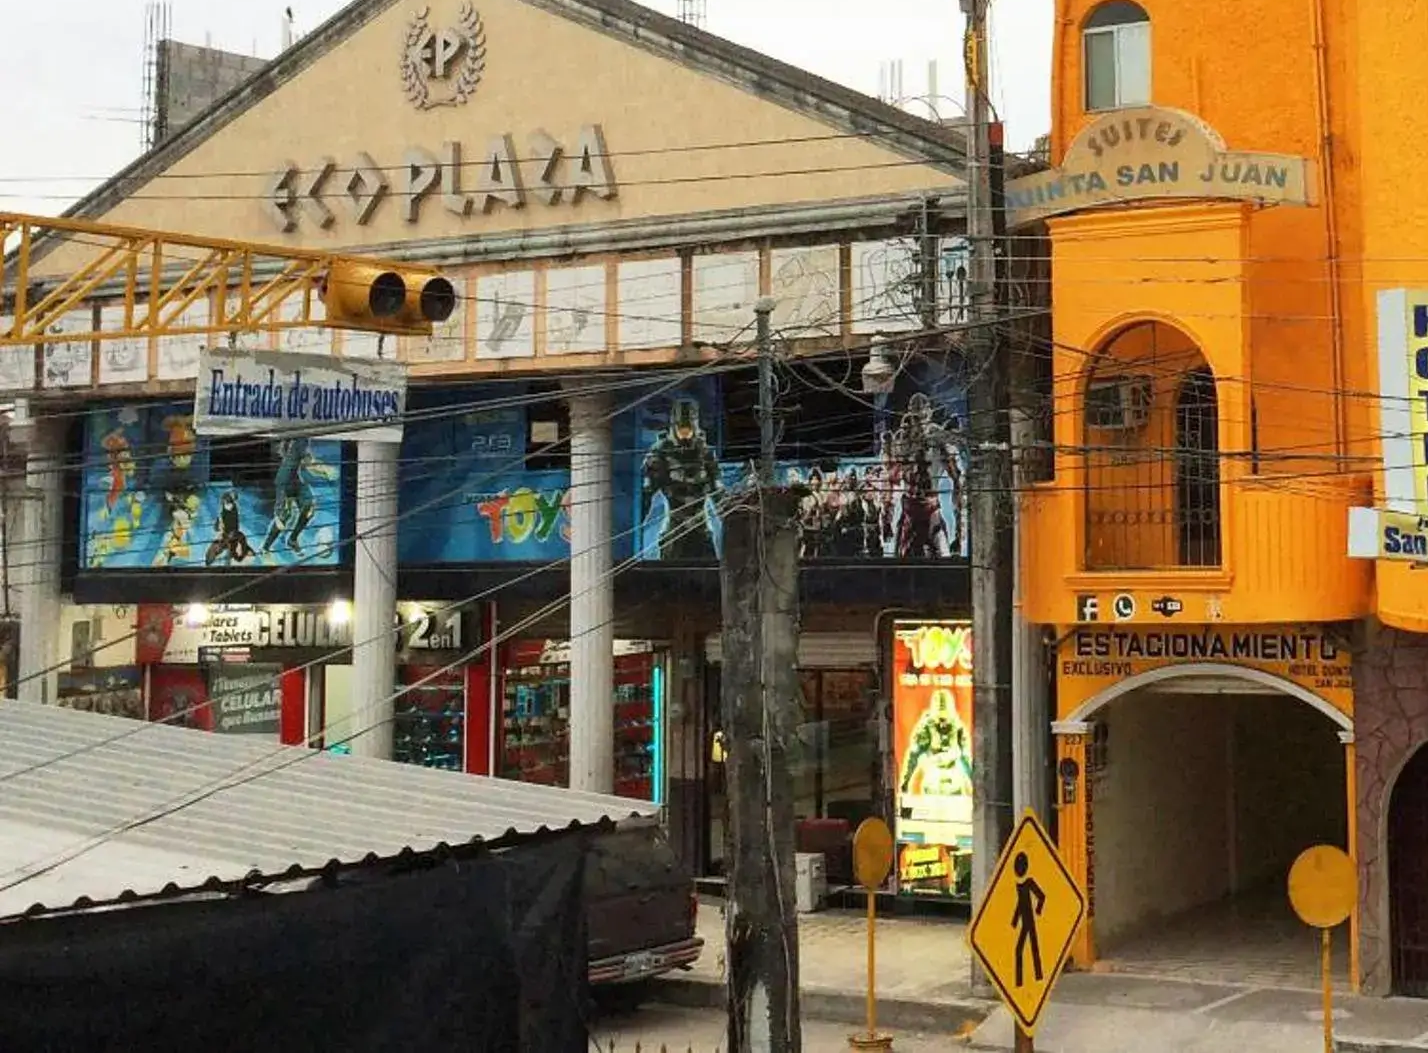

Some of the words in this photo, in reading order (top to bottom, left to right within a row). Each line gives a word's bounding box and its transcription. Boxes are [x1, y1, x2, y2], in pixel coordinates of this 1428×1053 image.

[1088, 117, 1187, 157] SUITES
[265, 151, 390, 233] ECO
[402, 124, 618, 225] PLAZA
[1117, 161, 1179, 185] SAN
[1200, 162, 1288, 189] JUAN
[208, 369, 283, 419] Entrada
[287, 370, 310, 420] de
[312, 373, 399, 422] autobuses
[1383, 526, 1427, 555] San
[210, 629, 253, 643] Tablets
[1076, 631, 1337, 661] ESTACIONAMIENTO
[1063, 661, 1132, 677] EXCLUSIVO
